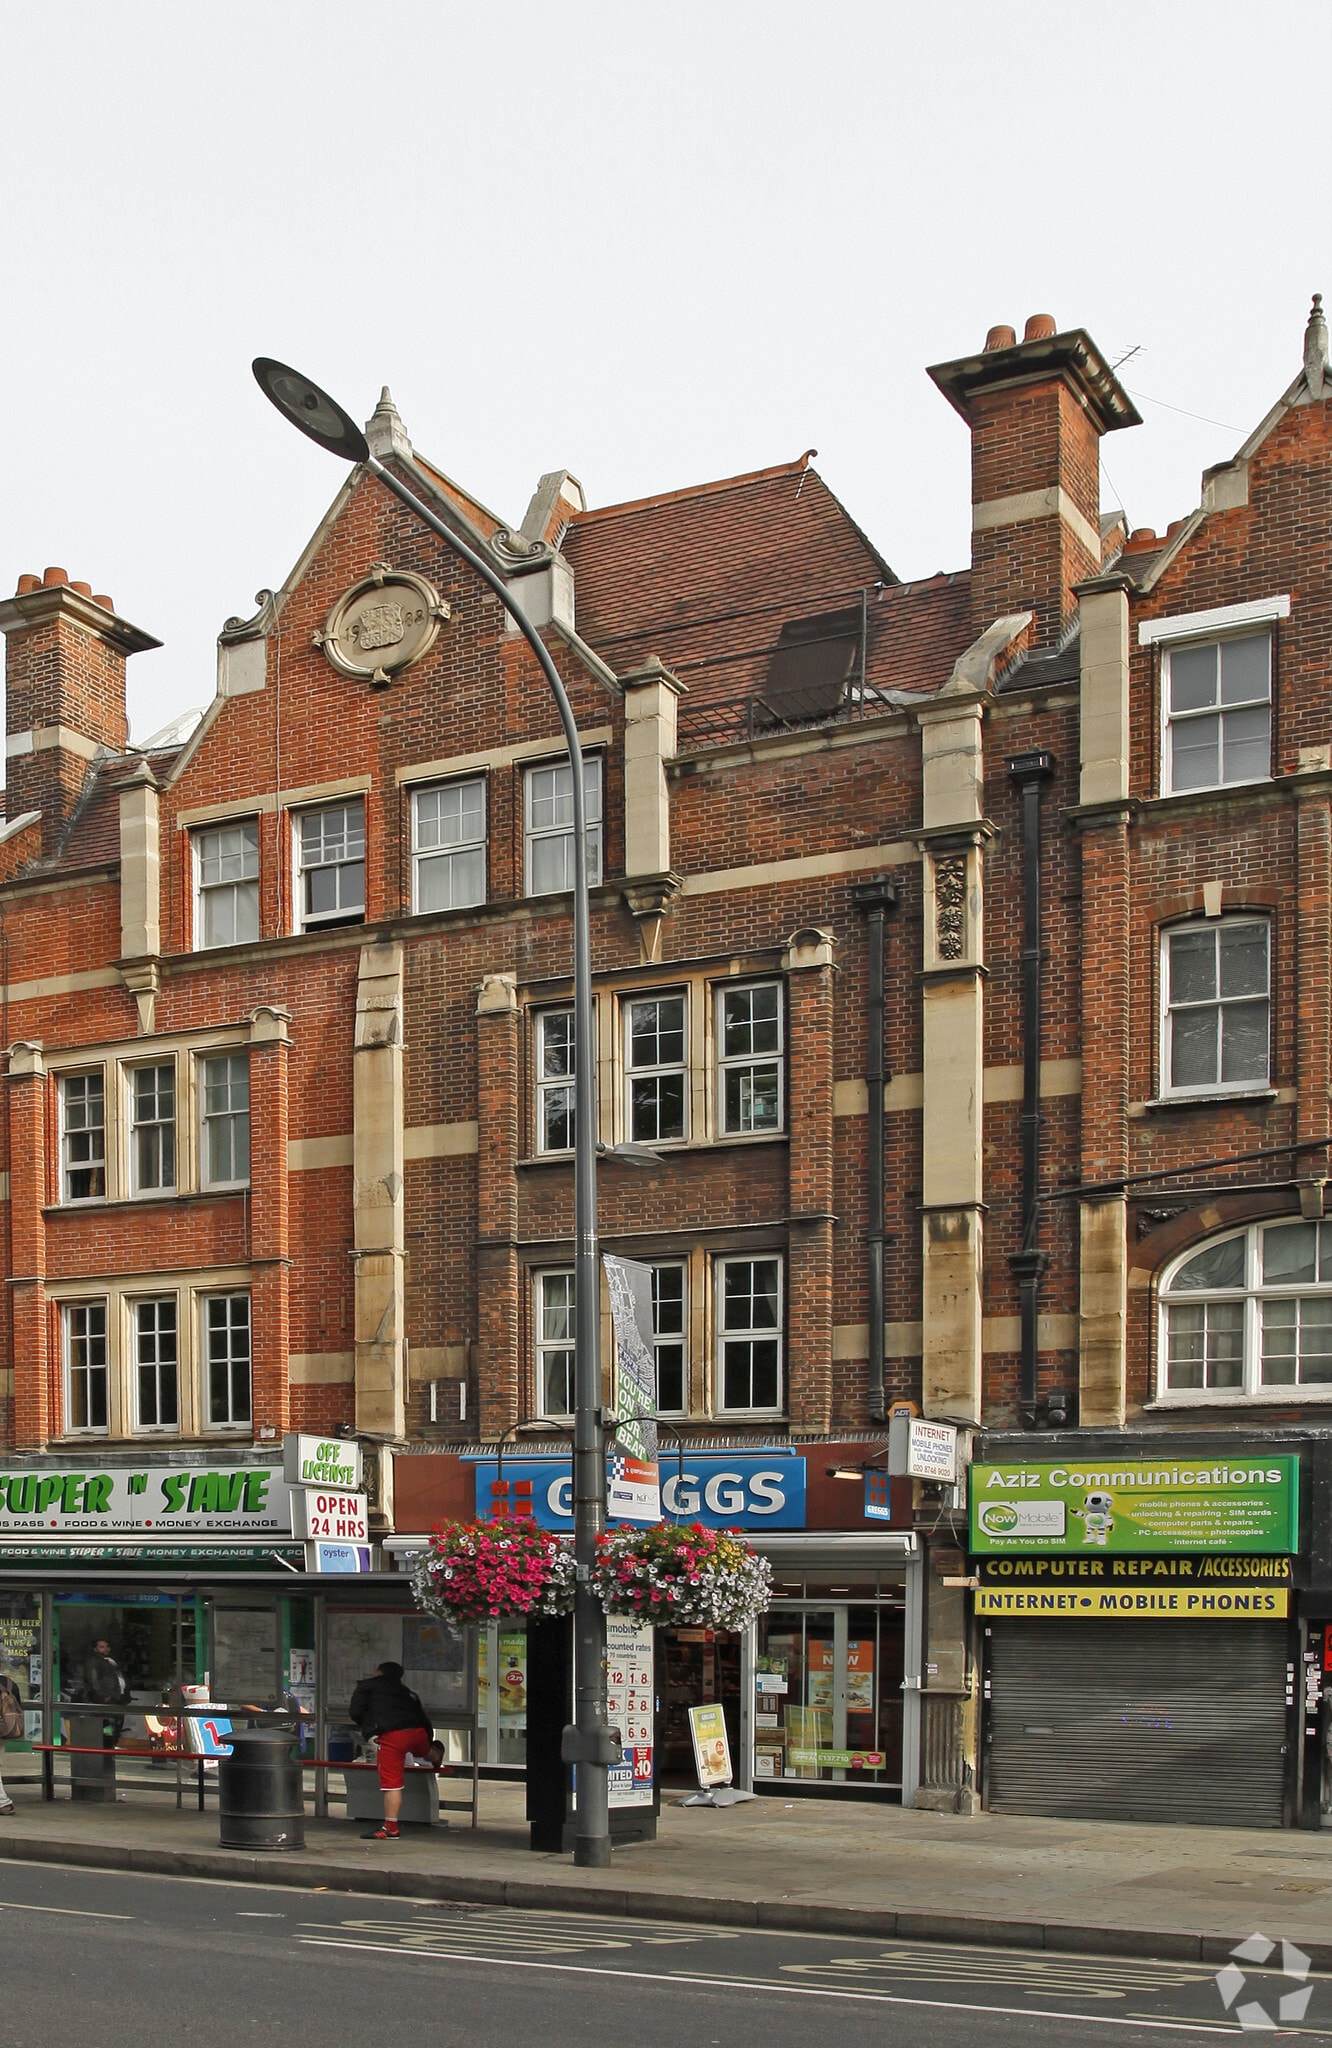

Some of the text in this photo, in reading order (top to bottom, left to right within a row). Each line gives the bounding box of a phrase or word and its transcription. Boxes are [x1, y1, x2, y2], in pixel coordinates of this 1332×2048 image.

[619, 1368, 651, 1412] YOU'RE
[619, 1389, 634, 1413] ON
[894, 1408, 910, 1416] ADT
[618, 1409, 640, 1438] OUR
[915, 1425, 950, 1442] INTERNET
[617, 1426, 646, 1460] BEAT
[912, 1438, 931, 1449] MOBILE
[932, 1442, 953, 1453] PHONES
[316, 1442, 342, 1463] OFF
[917, 1453, 948, 1465] UNLOCKING
[302, 1460, 355, 1485] LICENSE
[913, 1463, 923, 1473] 020
[986, 1467, 1282, 1488] Aziz Communications
[161, 1471, 271, 1513] SAVE
[547, 1471, 786, 1517] GGGS
[316, 1495, 358, 1515] OPEN
[1169, 1501, 1201, 1509] phones
[985, 1512, 1059, 1523] Now Mobile
[1184, 1510, 1222, 1518] repairing
[206, 1519, 278, 1527] EXCHANGE
[311, 1517, 365, 1538] 24 HRS
[1148, 1520, 1188, 1528] computer
[1223, 1519, 1254, 1527] repairs
[1210, 1529, 1264, 1537] photocopies
[990, 1538, 1004, 1546] Pay
[69, 1547, 104, 1556] SUPER
[116, 1547, 144, 1556] SAVE
[323, 1548, 349, 1558] oyster
[986, 1560, 1104, 1576] COMPUTER
[1112, 1560, 1193, 1575] REPAIR
[981, 1594, 1276, 1610] INTERNET MOBILE PHONES
[0, 1618, 41, 1627] ILLED BEER
[4, 1638, 24, 1646] NEWS
[606, 1643, 651, 1652] counted rates
[7, 1649, 28, 1657] MAGS
[822, 1655, 860, 1665] NW
[611, 1671, 623, 1684] 12
[641, 1672, 647, 1684] 8
[627, 1700, 647, 1711] 5 8
[628, 1727, 647, 1738] 6 9
[634, 1759, 651, 1777] £10
[607, 1770, 632, 1780] MITED
